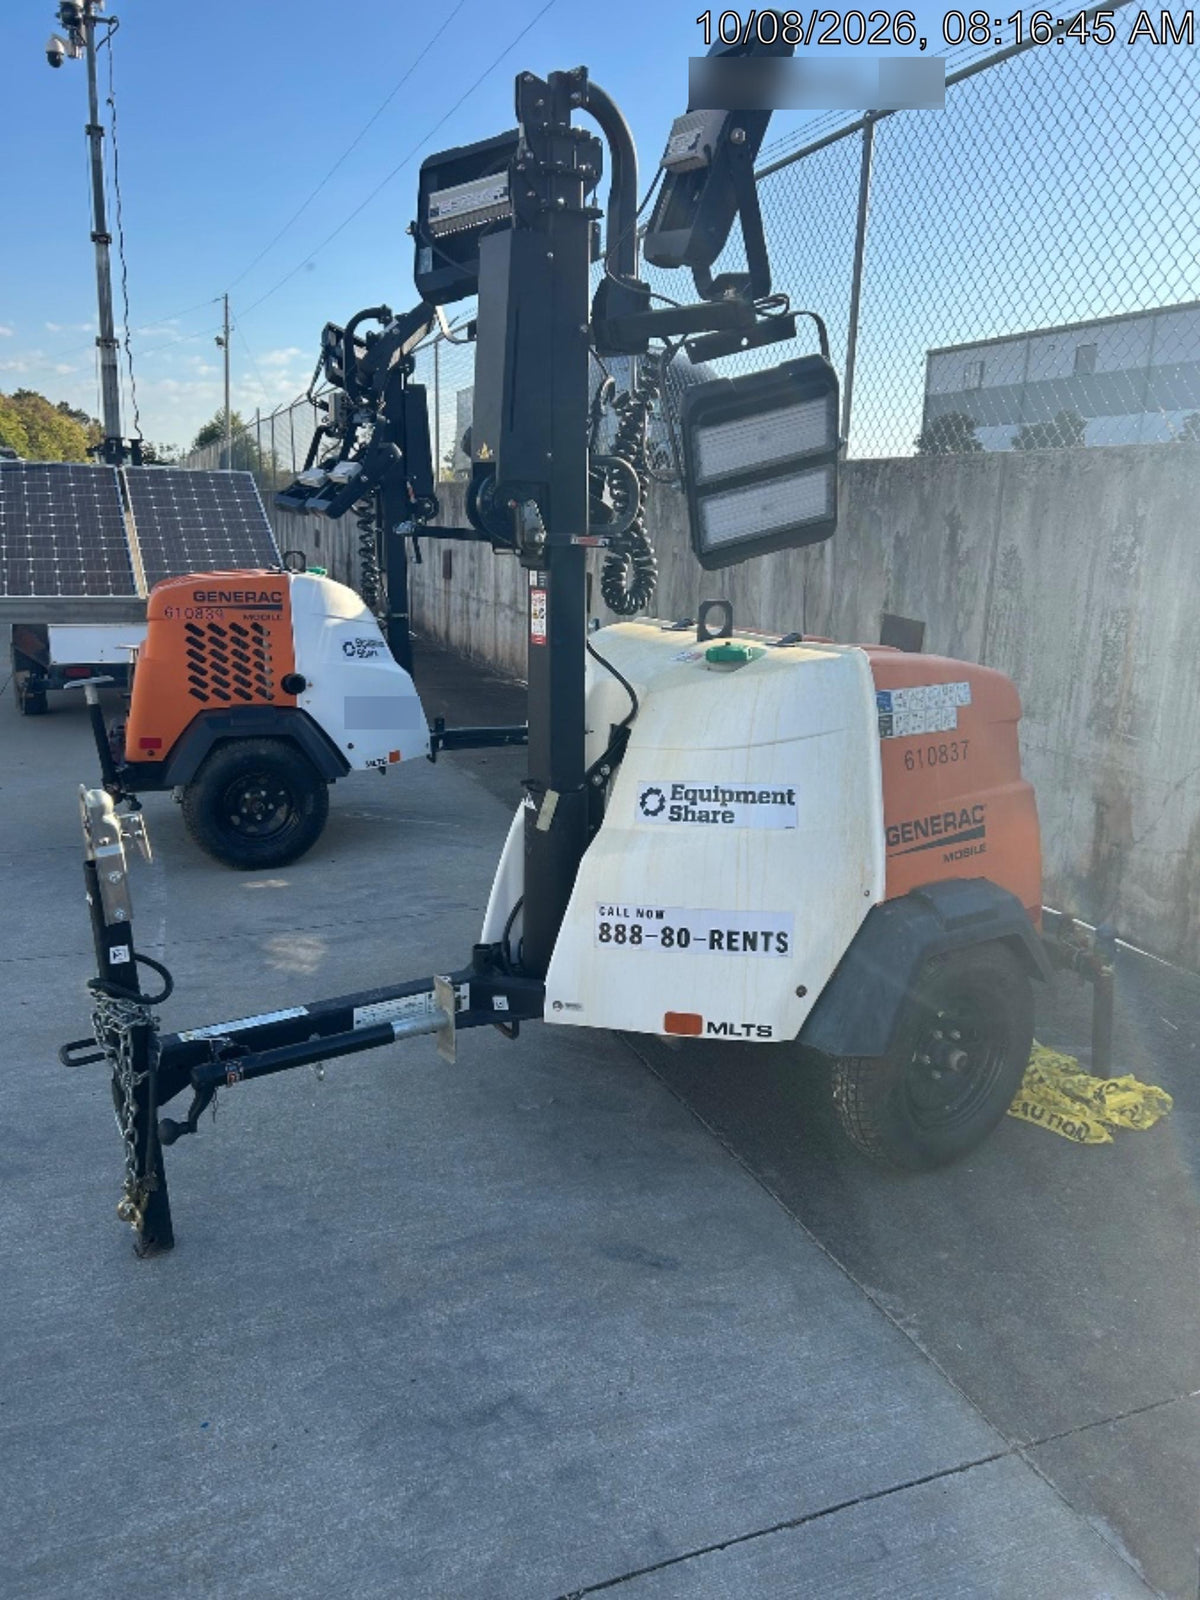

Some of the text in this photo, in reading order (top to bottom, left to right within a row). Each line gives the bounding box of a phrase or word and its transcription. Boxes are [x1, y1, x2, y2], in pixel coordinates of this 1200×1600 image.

[193, 591, 283, 603] GENERAC
[904, 739, 971, 771] 610837
[670, 783, 796, 807] Equipment
[668, 805, 736, 824] Share
[885, 804, 987, 847] GENERAC
[942, 843, 988, 864] MOBILE
[599, 906, 665, 920] CALL NOW
[598, 922, 790, 954] 888-80-RENTS
[707, 1021, 773, 1038] MLTS
